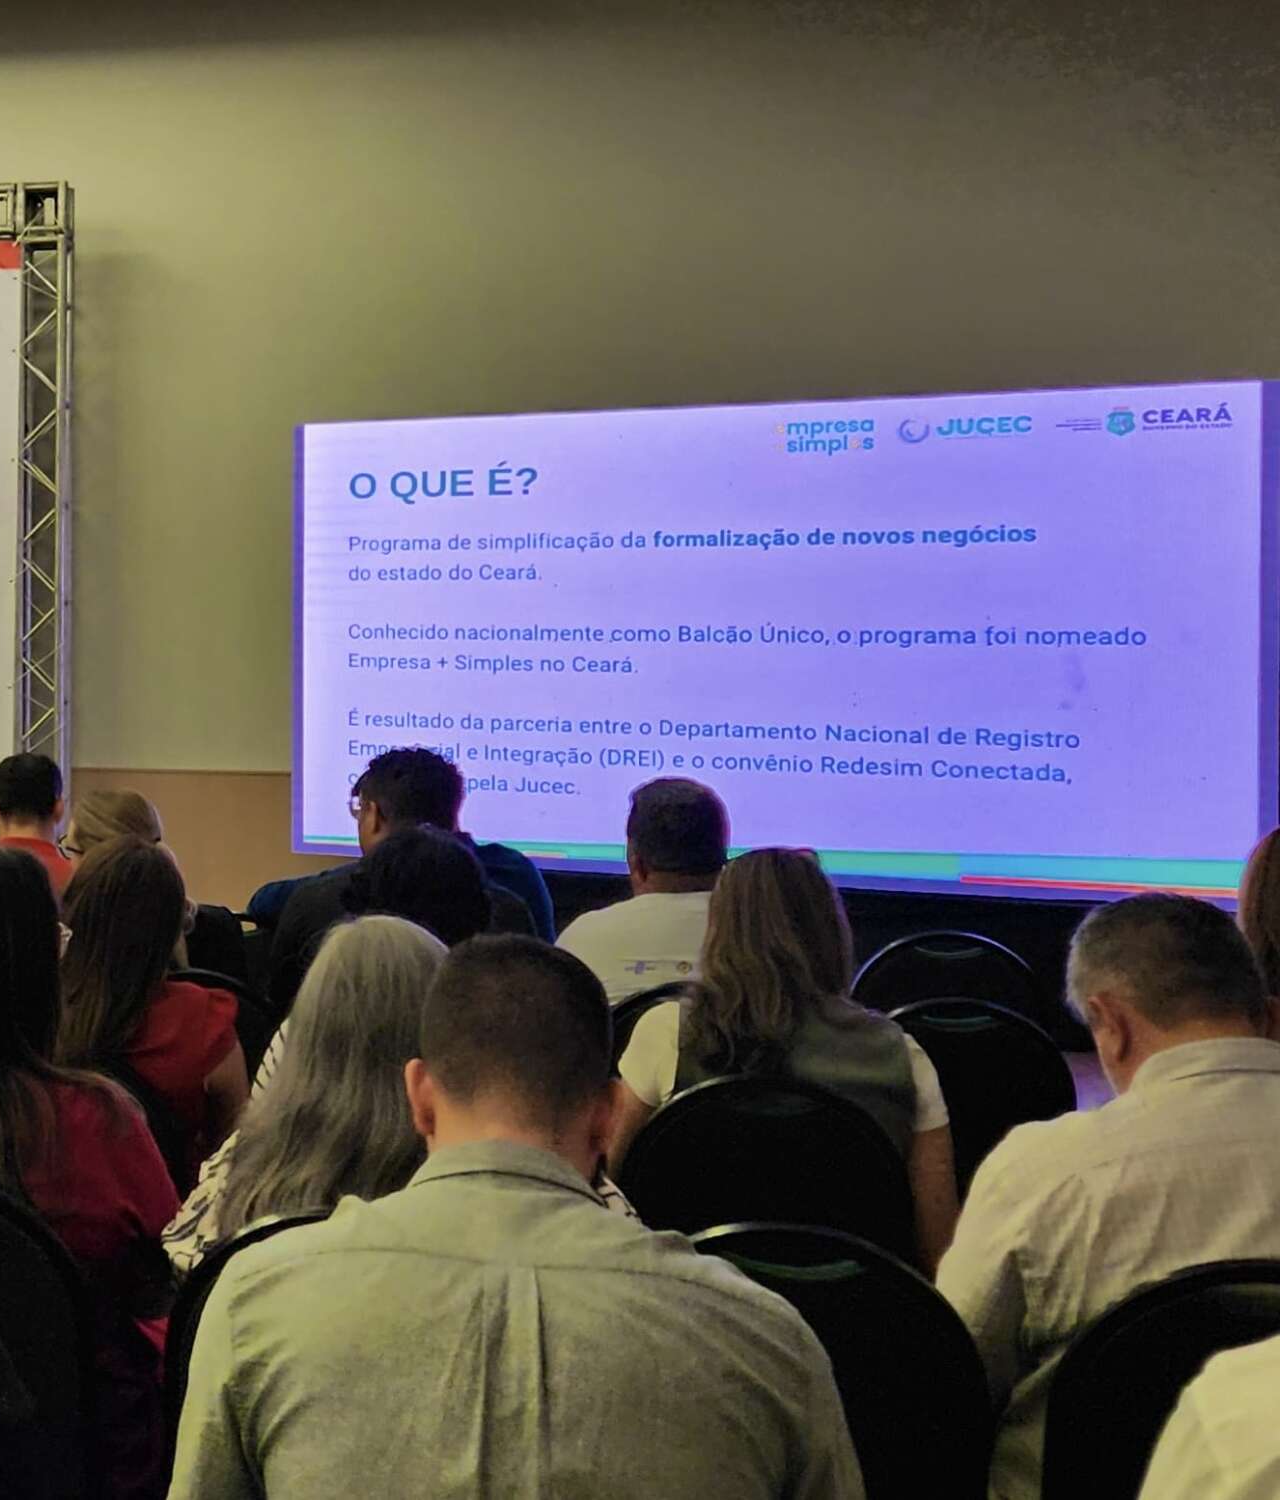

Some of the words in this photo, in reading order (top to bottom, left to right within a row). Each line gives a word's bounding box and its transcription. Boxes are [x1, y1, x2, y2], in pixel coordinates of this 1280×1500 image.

[1142, 402, 1232, 424] CEARÁ
[350, 473, 376, 499] O
[391, 470, 473, 504] QUE
[489, 461, 537, 496] É?
[349, 536, 441, 555] Programa
[448, 535, 471, 550] de
[478, 532, 614, 552] simplificação
[621, 531, 646, 548] da
[653, 529, 800, 550] formalização
[807, 528, 835, 545] de
[843, 531, 914, 544] novos
[922, 525, 1036, 547] negócios
[349, 566, 371, 581] do
[378, 565, 442, 581] estado
[449, 564, 472, 580] do
[479, 564, 541, 580] Ceará.
[349, 624, 448, 640] Conhecido
[455, 624, 604, 641] nacionalmente
[611, 629, 670, 642] como
[679, 626, 752, 644] Balcão
[761, 622, 829, 646] Único,
[836, 629, 852, 644] o
[860, 630, 976, 648] programa
[984, 626, 1016, 646] foi
[1026, 627, 1146, 647] nomeado
[349, 653, 430, 671] Empresa
[436, 656, 449, 669] +
[455, 655, 533, 674] Simples
[540, 660, 565, 672] no
[572, 656, 638, 673] Ceará.
[348, 707, 360, 727] É
[365, 712, 454, 728] resultado
[460, 714, 483, 730] da
[491, 717, 572, 734] parceria
[579, 720, 631, 734] entre
[638, 722, 653, 736] o
[660, 720, 816, 740] Departamento
[826, 724, 928, 744] Nacional
[937, 727, 967, 745] de
[976, 728, 1079, 751] Registro
[349, 740, 460, 761] Empial
[466, 747, 479, 761] e
[485, 745, 592, 767] Integração
[600, 748, 664, 770] (DREI)
[672, 754, 685, 769] e
[691, 755, 705, 769] o
[712, 754, 813, 772] convênio
[821, 756, 922, 776] Redesim
[931, 760, 1072, 784] Conectada,
[468, 775, 508, 793] pela
[515, 777, 580, 794] Jucec.
